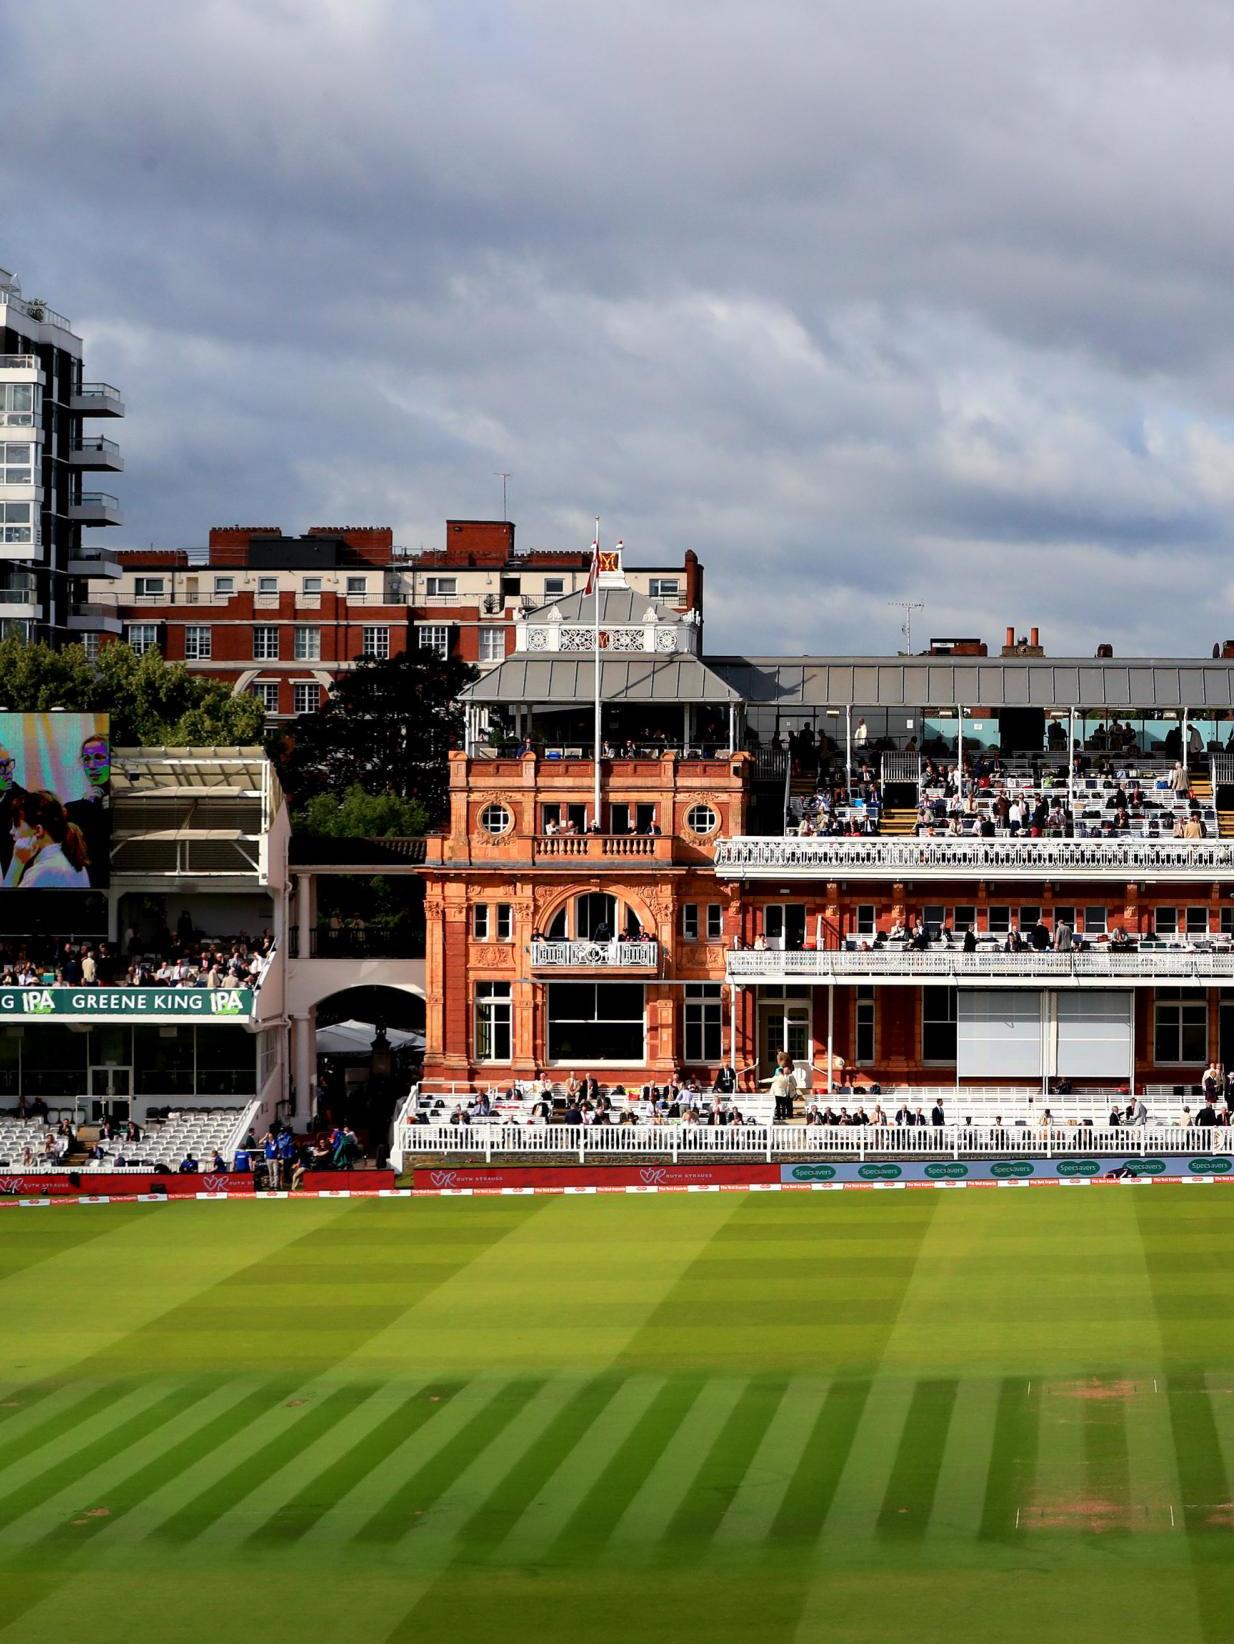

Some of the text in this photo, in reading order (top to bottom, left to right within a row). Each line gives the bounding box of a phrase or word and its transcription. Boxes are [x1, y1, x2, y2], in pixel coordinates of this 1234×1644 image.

[23, 990, 55, 1012] IPA
[72, 995, 147, 1009] GREENE
[154, 995, 203, 1009] KING
[210, 990, 243, 1013] IPA
[928, 1166, 964, 1175] Specsavers
[994, 1166, 1031, 1174] Specsavers
[1060, 1164, 1096, 1173] Specsavers
[1126, 1163, 1162, 1172] Specsavers
[1192, 1162, 1228, 1170] Specsavers
[795, 1168, 832, 1177] Specsavers
[862, 1168, 898, 1176] Specsavers
